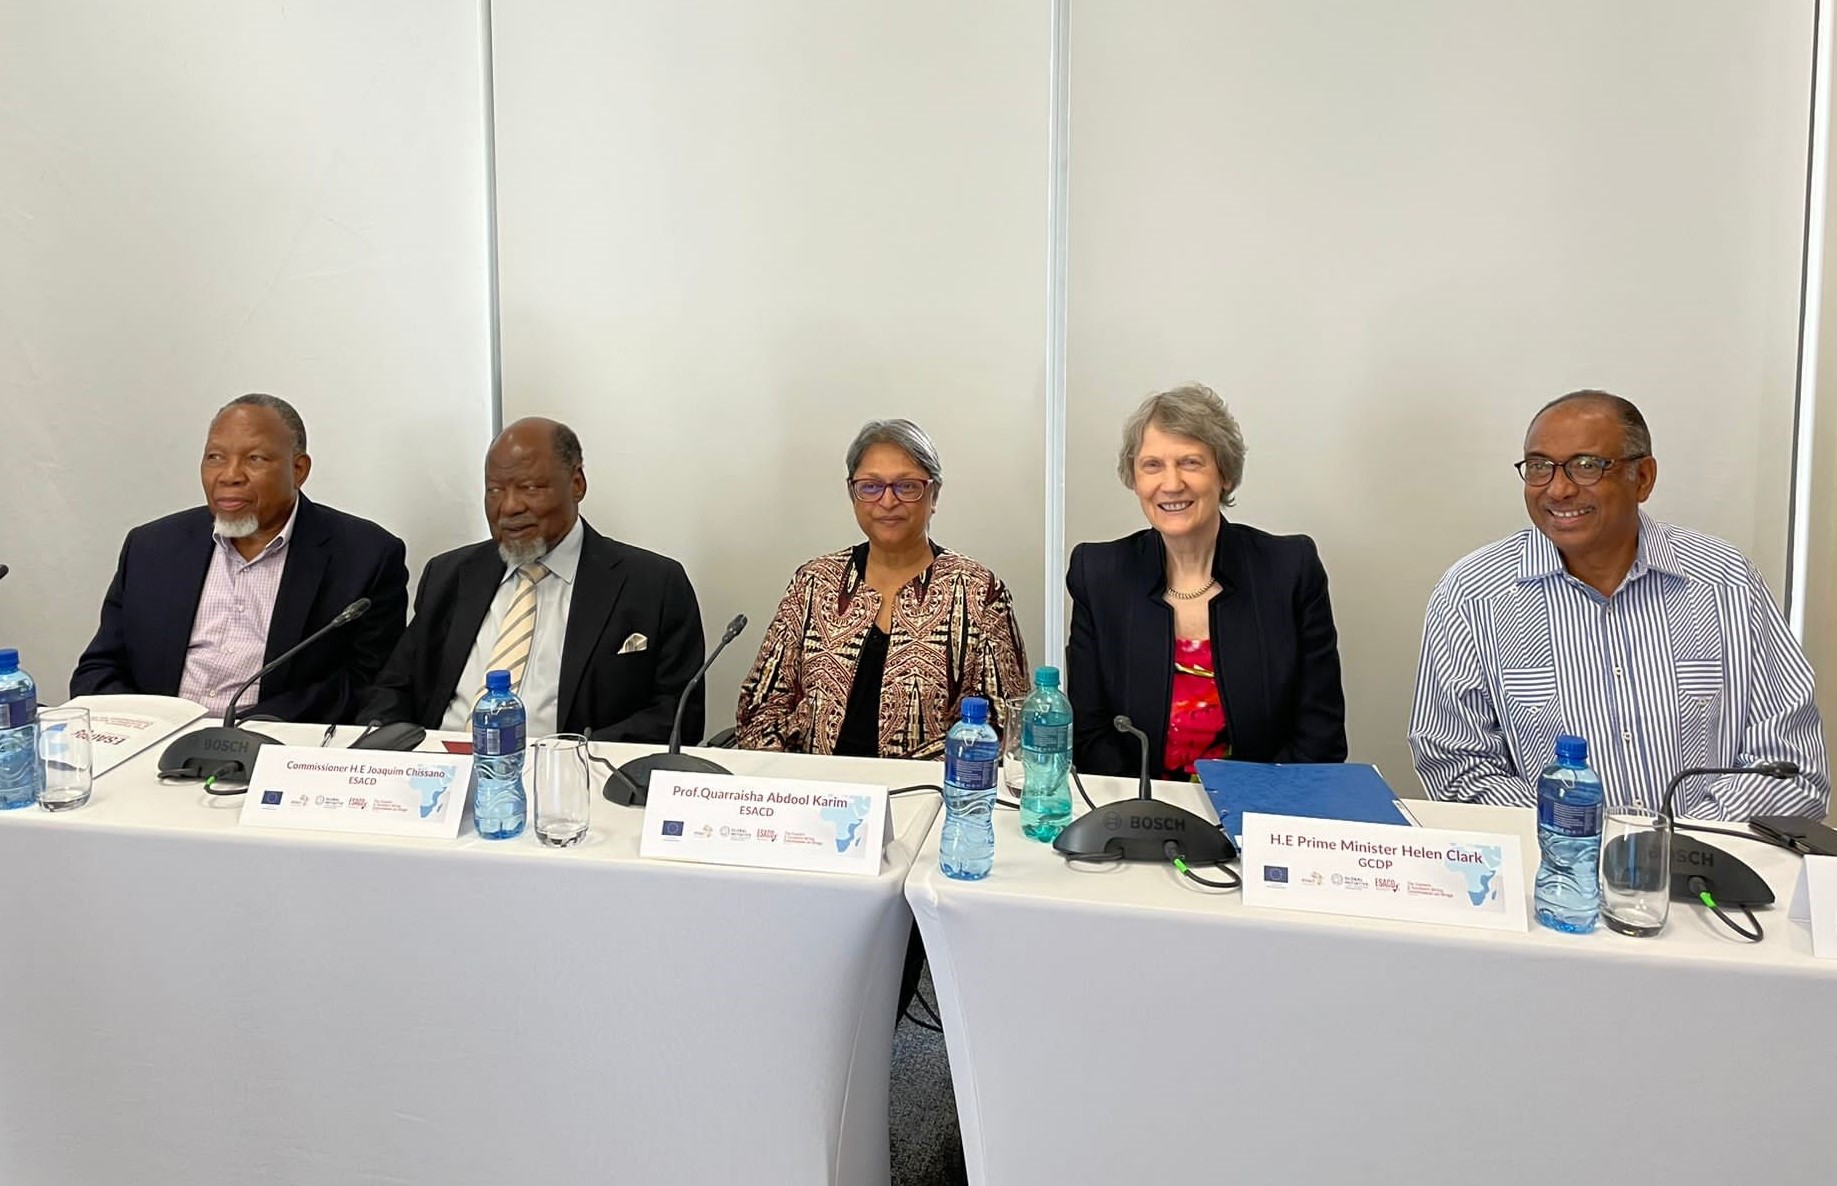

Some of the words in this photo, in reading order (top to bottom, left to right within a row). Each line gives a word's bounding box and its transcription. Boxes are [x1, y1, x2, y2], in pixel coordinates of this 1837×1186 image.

[204, 738, 249, 753] BOSCH
[286, 760, 348, 774] Commissioner
[350, 764, 366, 774] H.E
[367, 765, 404, 778] Joaquim
[405, 767, 445, 779] Chissano
[348, 777, 377, 786] ESACD
[672, 785, 764, 803] Prof.Quarraisha
[766, 791, 810, 806] Abdool
[812, 795, 848, 809] Karim
[739, 805, 774, 817] ESACD
[1129, 815, 1186, 831] BOSCH
[1270, 833, 1294, 847] H.E
[1297, 836, 1337, 850] Prime
[1340, 839, 1398, 856] Minister
[1401, 844, 1443, 860] Helen
[1446, 849, 1483, 864] Clark
[1358, 858, 1394, 870] GCDP
